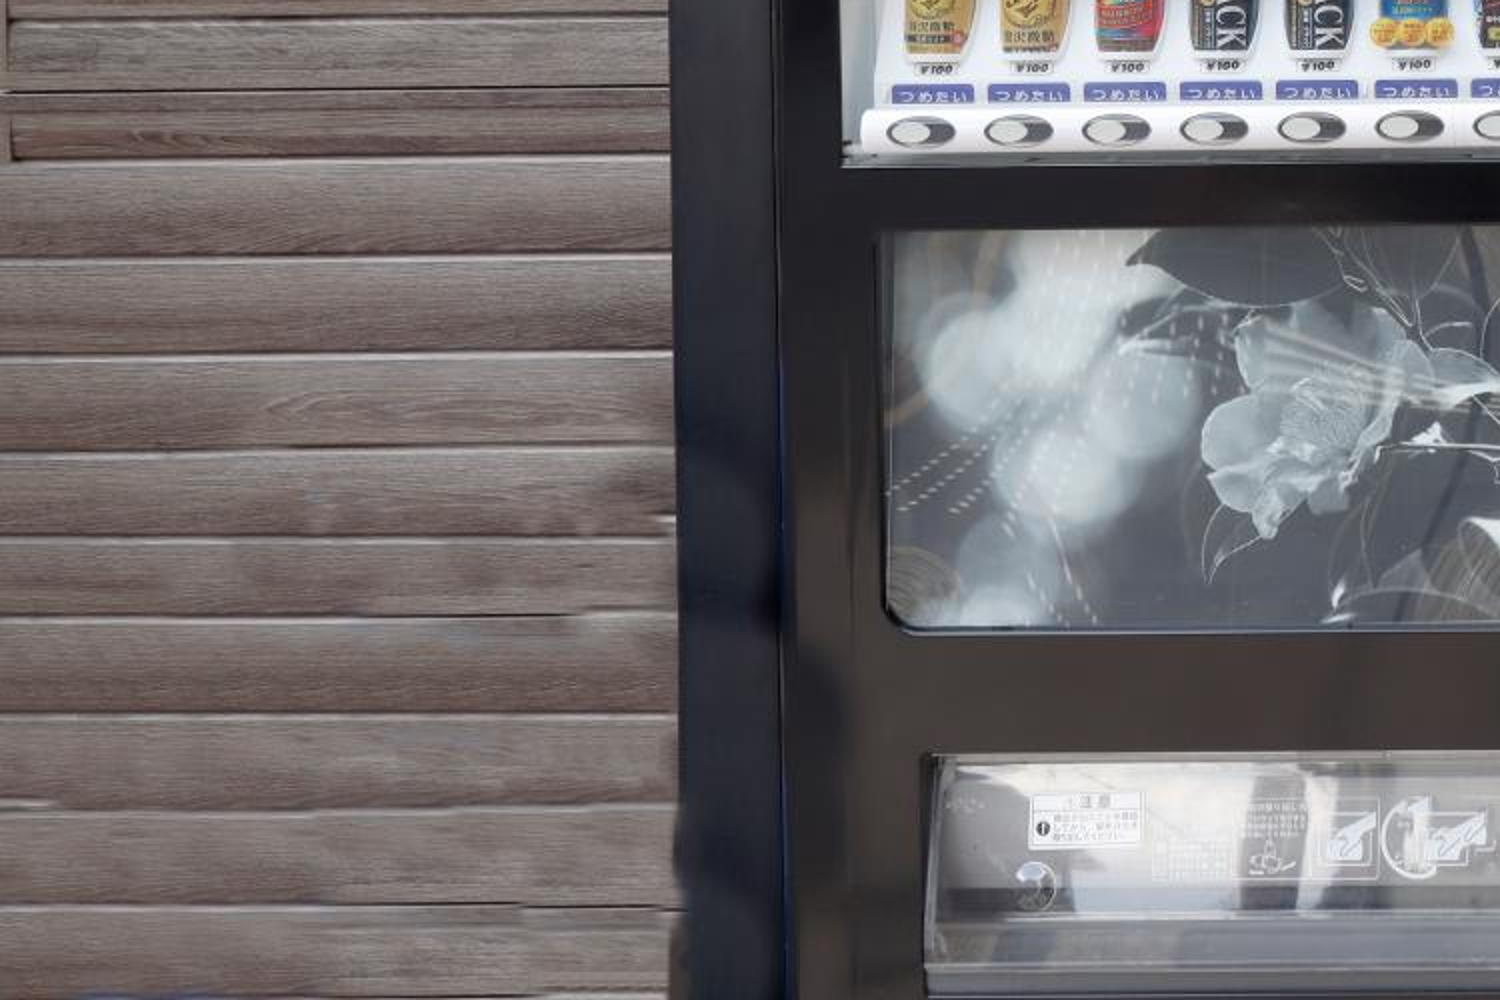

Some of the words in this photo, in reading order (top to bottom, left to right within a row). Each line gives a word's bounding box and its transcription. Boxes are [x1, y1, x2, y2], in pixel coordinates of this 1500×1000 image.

[921, 64, 953, 74] ¥100
[1017, 63, 1049, 73] ¥100
[1112, 62, 1145, 72] ¥100
[1206, 61, 1240, 71] ¥100
[1302, 60, 1335, 71] ¥100
[1399, 59, 1431, 70] ¥100
[900, 91, 968, 103] つめたい
[996, 90, 1063, 102] つめたい
[1092, 89, 1160, 101] つめたい
[1188, 88, 1256, 100] つめたい
[1284, 87, 1352, 99] つめたい
[1383, 86, 1450, 98] つめたい
